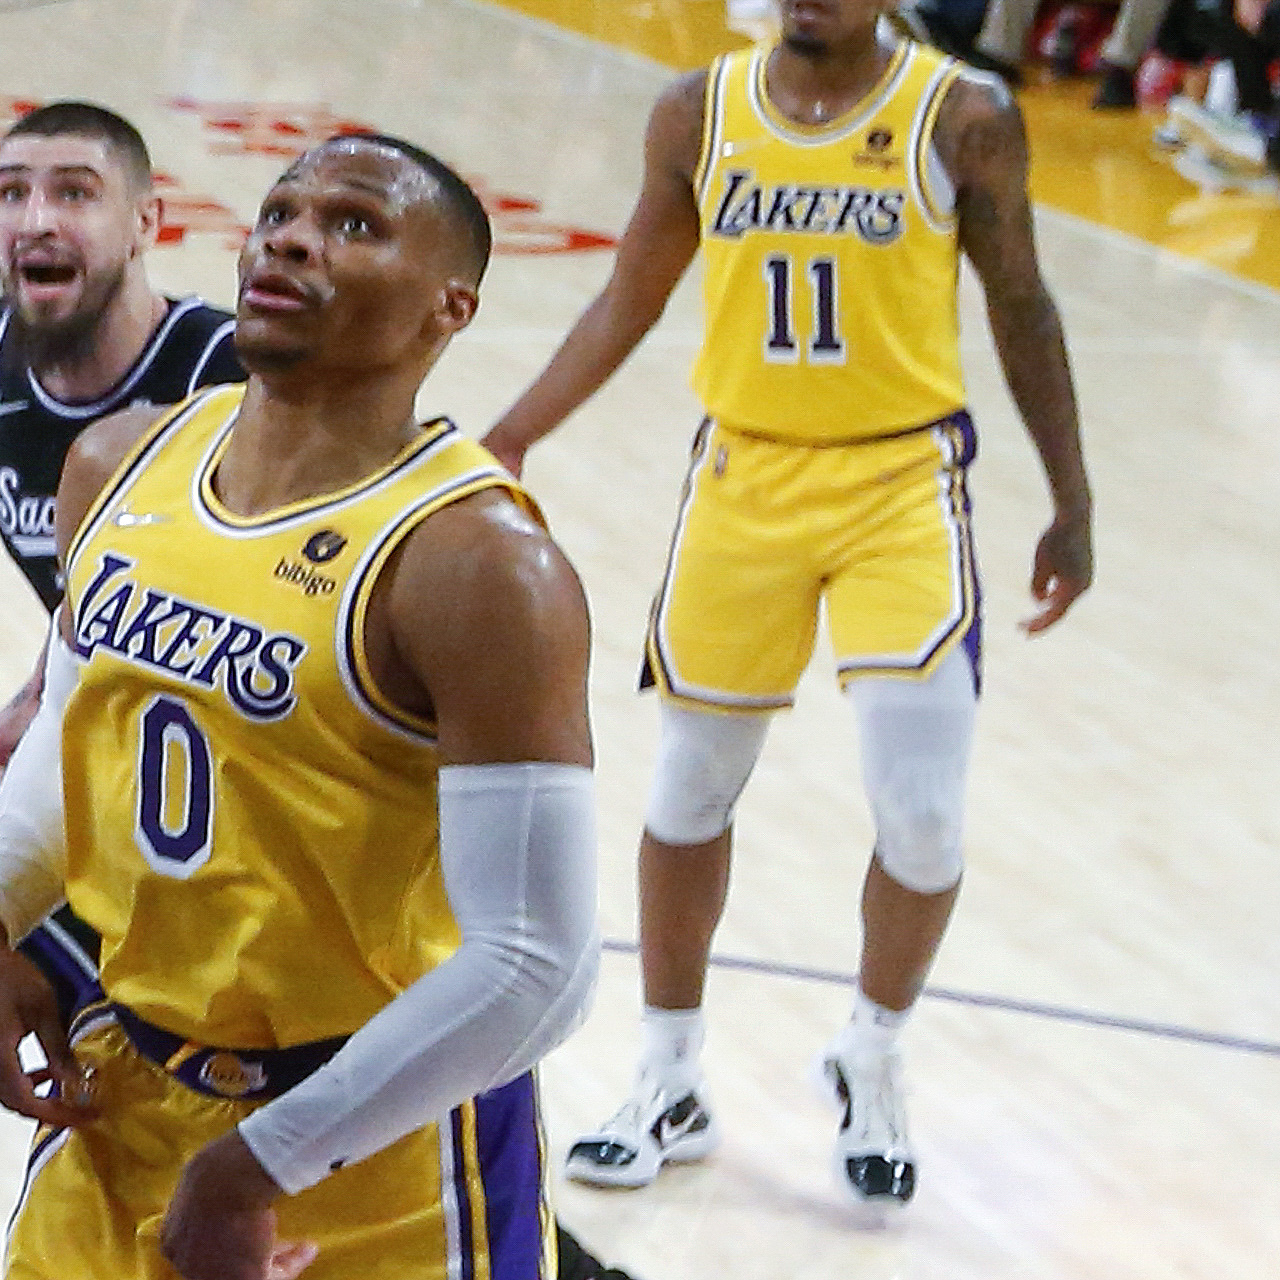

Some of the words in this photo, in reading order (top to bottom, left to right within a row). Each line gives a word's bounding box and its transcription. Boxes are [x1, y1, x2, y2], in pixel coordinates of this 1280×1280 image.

[712, 167, 906, 246] LAKERS
[763, 253, 846, 364] 11
[272, 556, 337, 597] bibigo
[73, 552, 310, 724] LAKERS
[136, 695, 215, 877] 0
